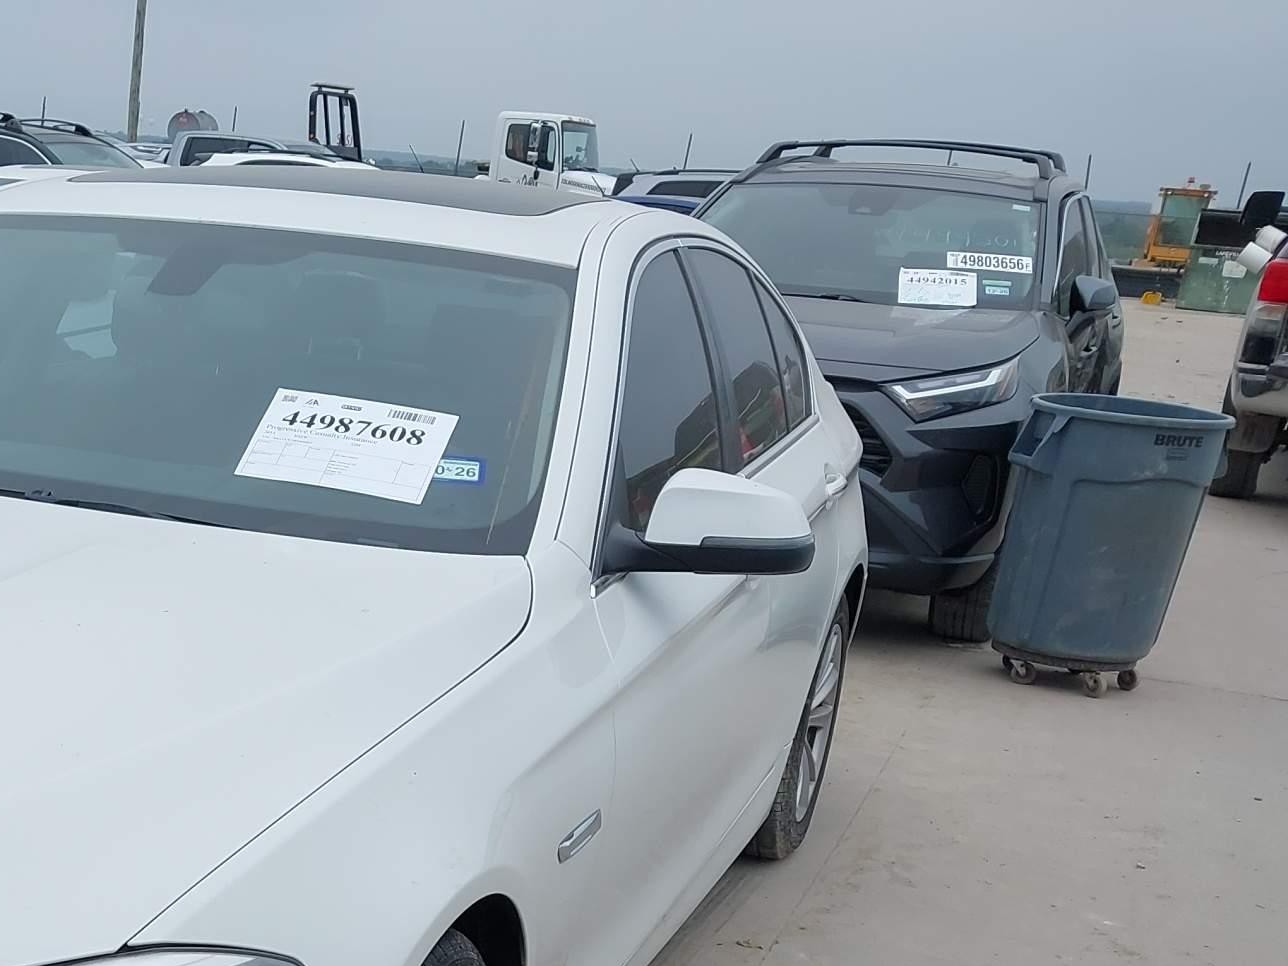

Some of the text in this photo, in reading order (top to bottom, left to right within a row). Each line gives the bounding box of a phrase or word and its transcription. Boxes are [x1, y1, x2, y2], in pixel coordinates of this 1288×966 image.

[960, 254, 1024, 271] 49803656
[907, 277, 968, 286] 44942015
[282, 410, 427, 446] 44987608
[1154, 434, 1204, 448] BRUTE
